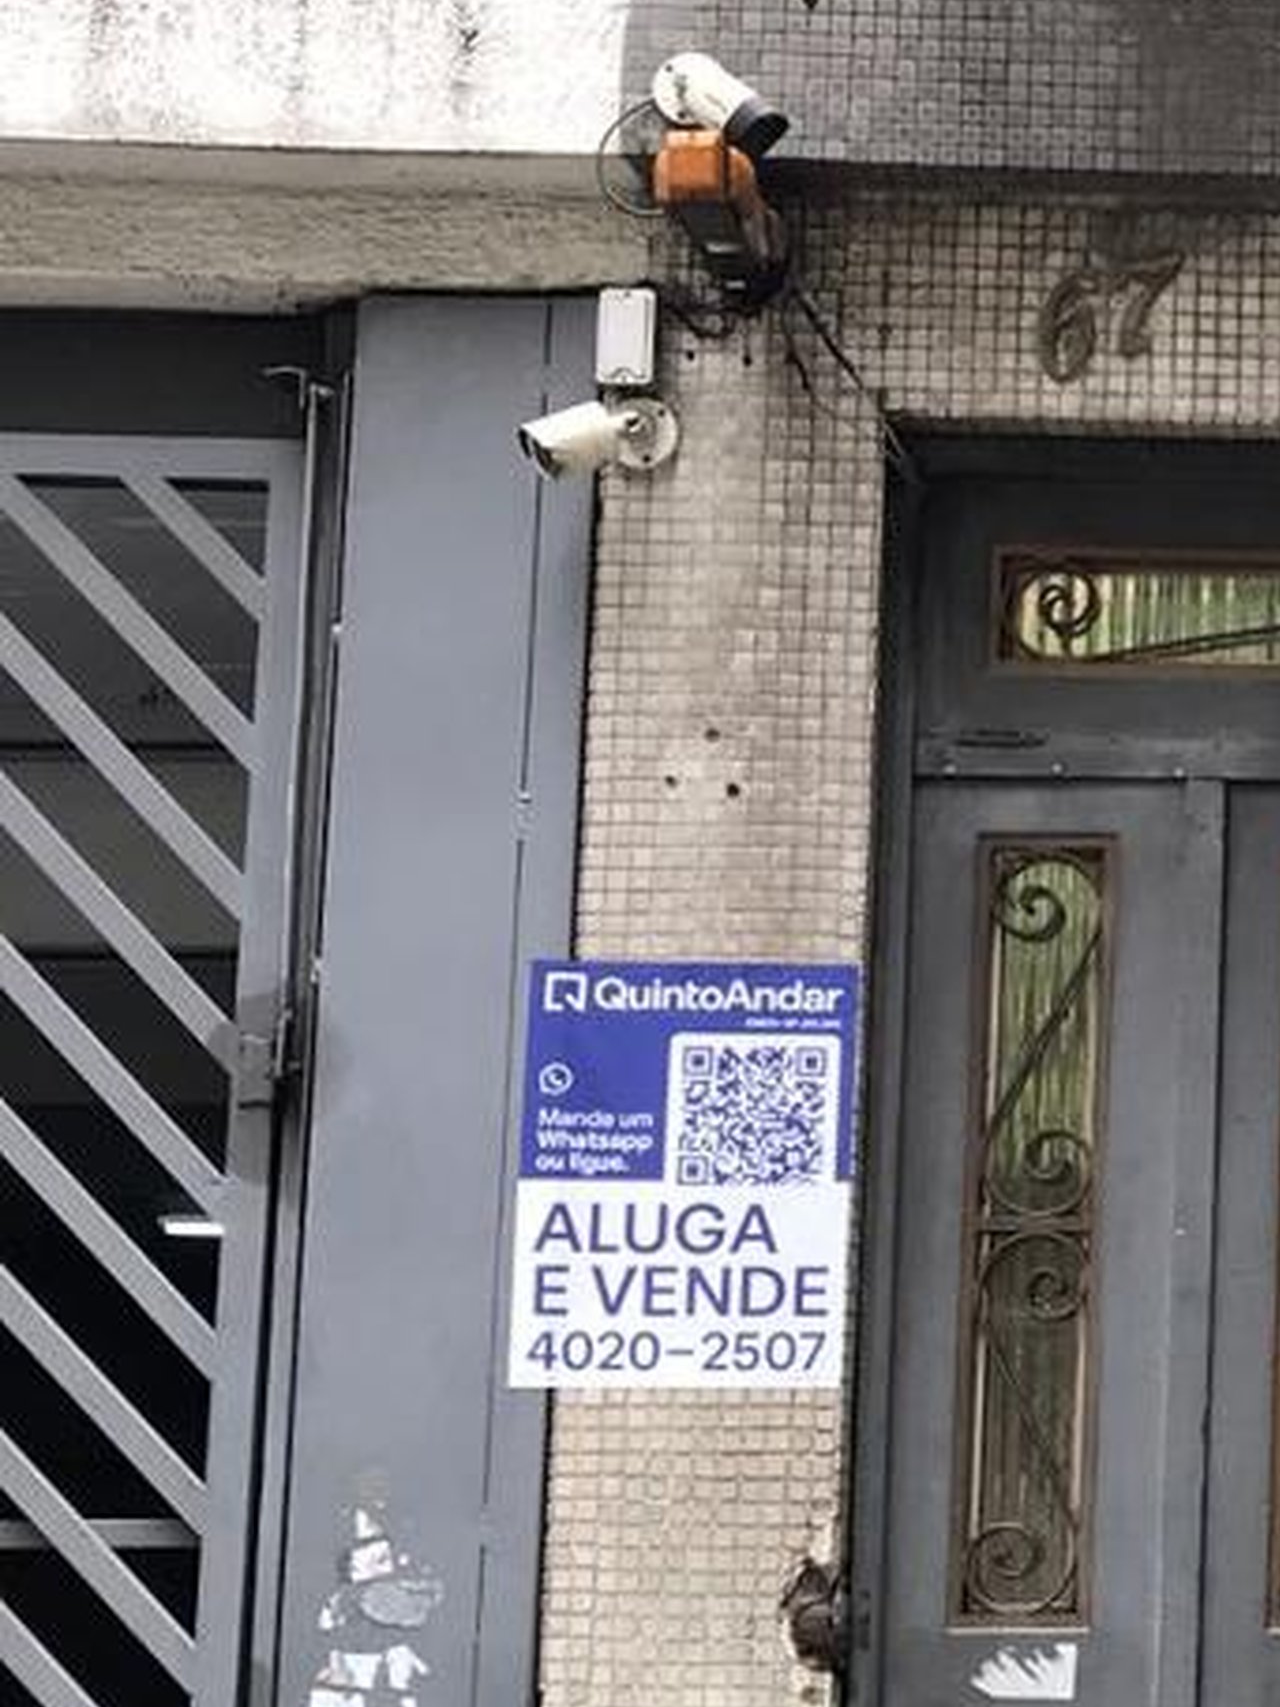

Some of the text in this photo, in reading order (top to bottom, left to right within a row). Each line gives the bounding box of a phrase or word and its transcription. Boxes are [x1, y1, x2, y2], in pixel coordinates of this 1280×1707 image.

[1037, 251, 1184, 383] 67
[594, 976, 844, 1013] QuintoAndar
[618, 1112, 654, 1129] um
[535, 1154, 565, 1172] ou
[534, 1202, 778, 1255] ALUGA
[534, 1265, 829, 1318] E VENDE
[527, 1332, 826, 1372] 4020-2507
